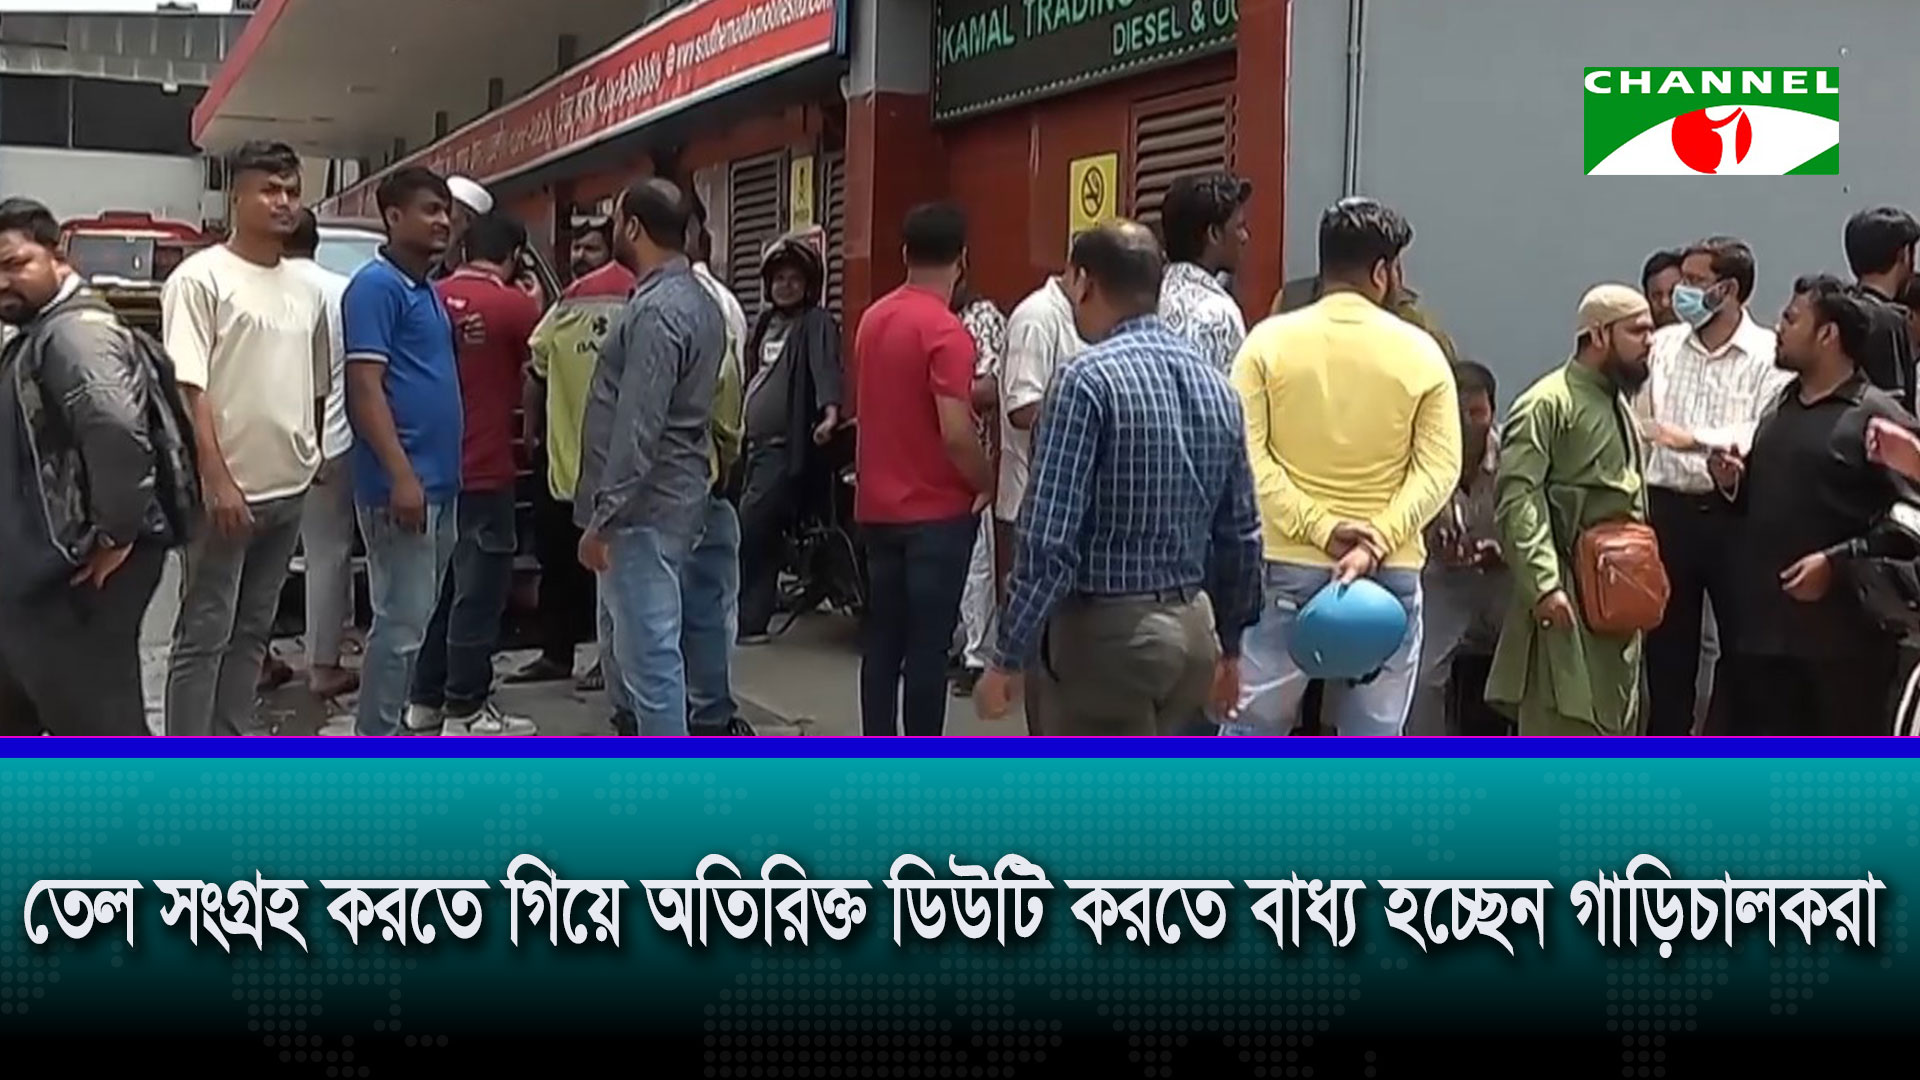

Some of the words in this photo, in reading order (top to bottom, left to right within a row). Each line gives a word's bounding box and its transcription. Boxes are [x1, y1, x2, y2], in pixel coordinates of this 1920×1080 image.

[941, 4, 1014, 66] KAMAL
[1112, 8, 1183, 56] DIESEL
[1190, 0, 1206, 33] &
